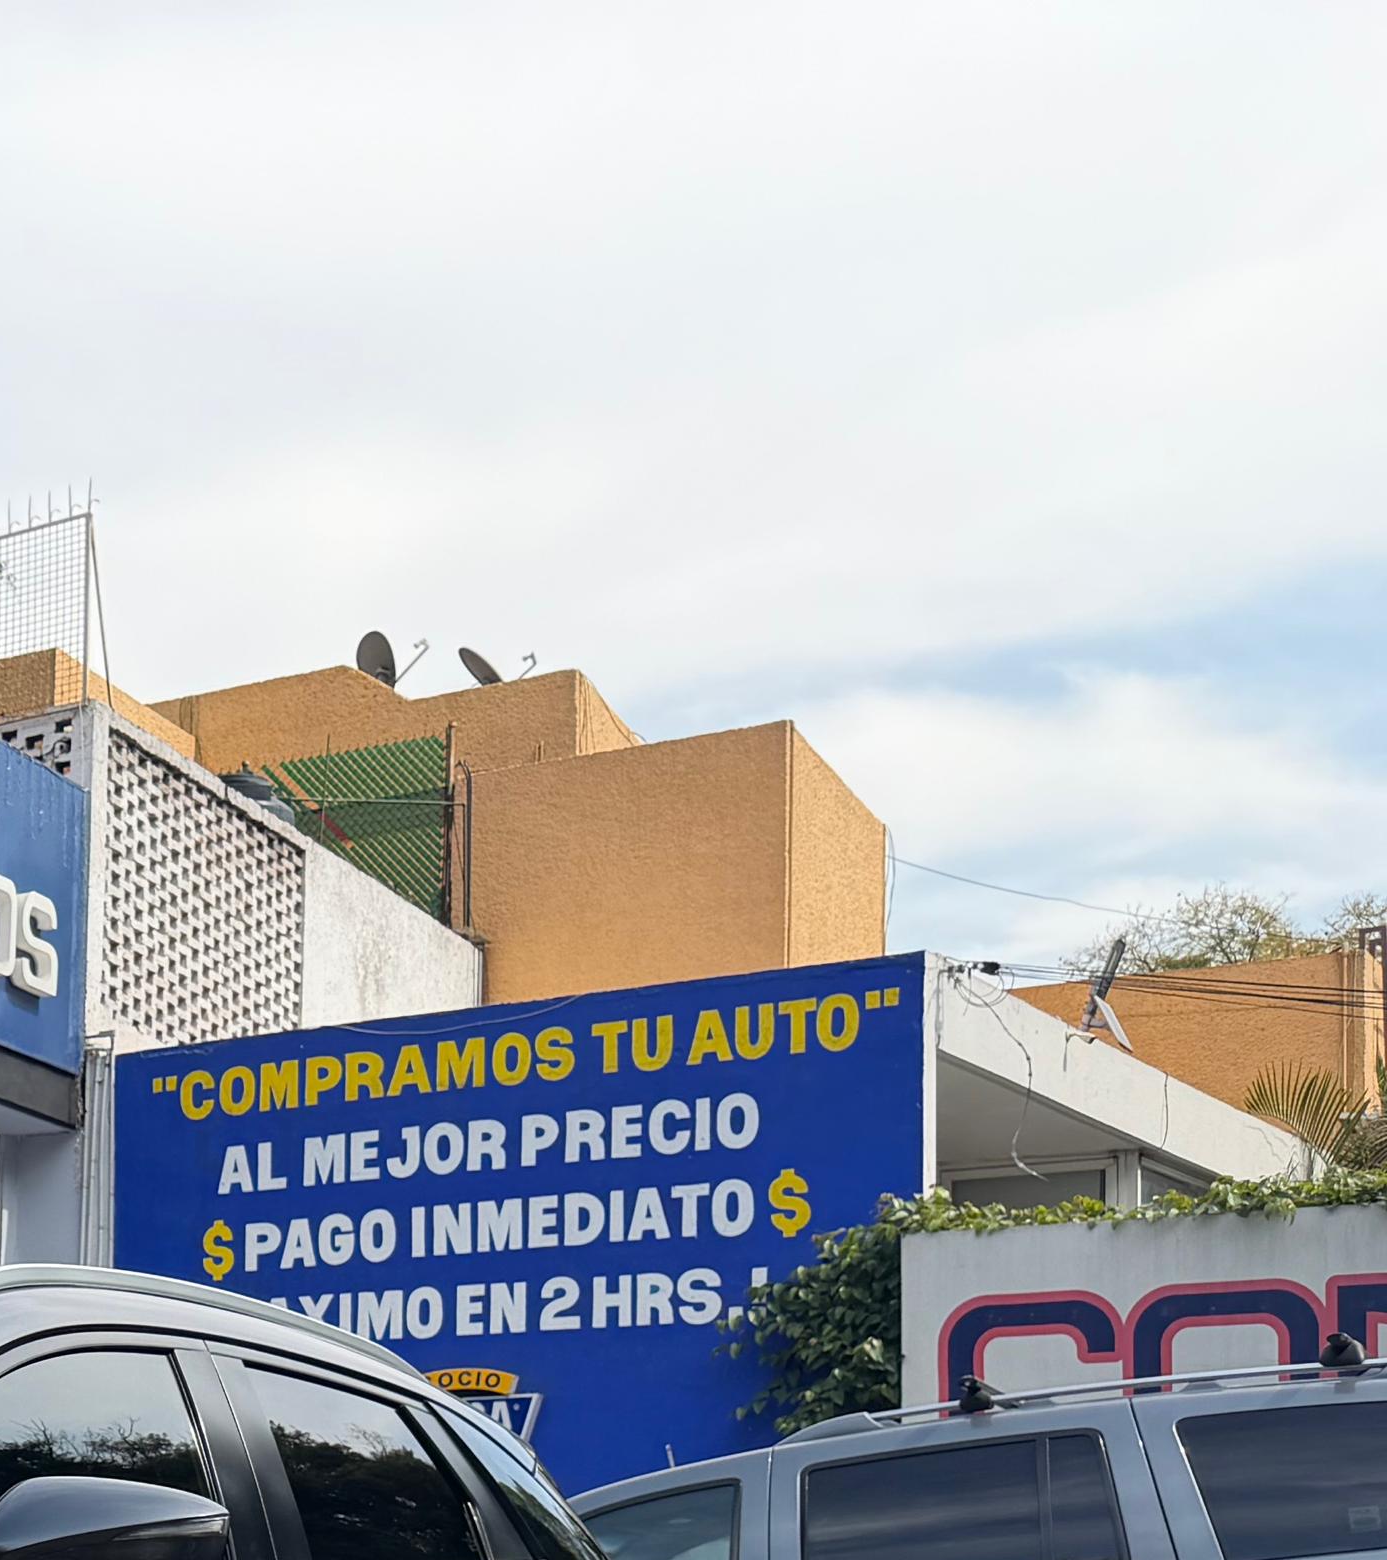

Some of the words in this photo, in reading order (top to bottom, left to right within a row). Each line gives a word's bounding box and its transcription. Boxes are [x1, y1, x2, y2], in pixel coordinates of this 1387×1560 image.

[151, 1028, 575, 1121] "COMPRAMOS
[592, 1016, 673, 1074] TU
[689, 987, 900, 1066] AUTO"
[218, 1142, 287, 1195] AL
[303, 1119, 507, 1187] MEJOR
[521, 1093, 759, 1167] PRECIO
[245, 1208, 396, 1273] PAGO
[411, 1179, 754, 1259] INMEDIATO
[456, 1282, 527, 1337] EN
[539, 1275, 582, 1332] 2
[427, 1371, 501, 1388] OCIO
